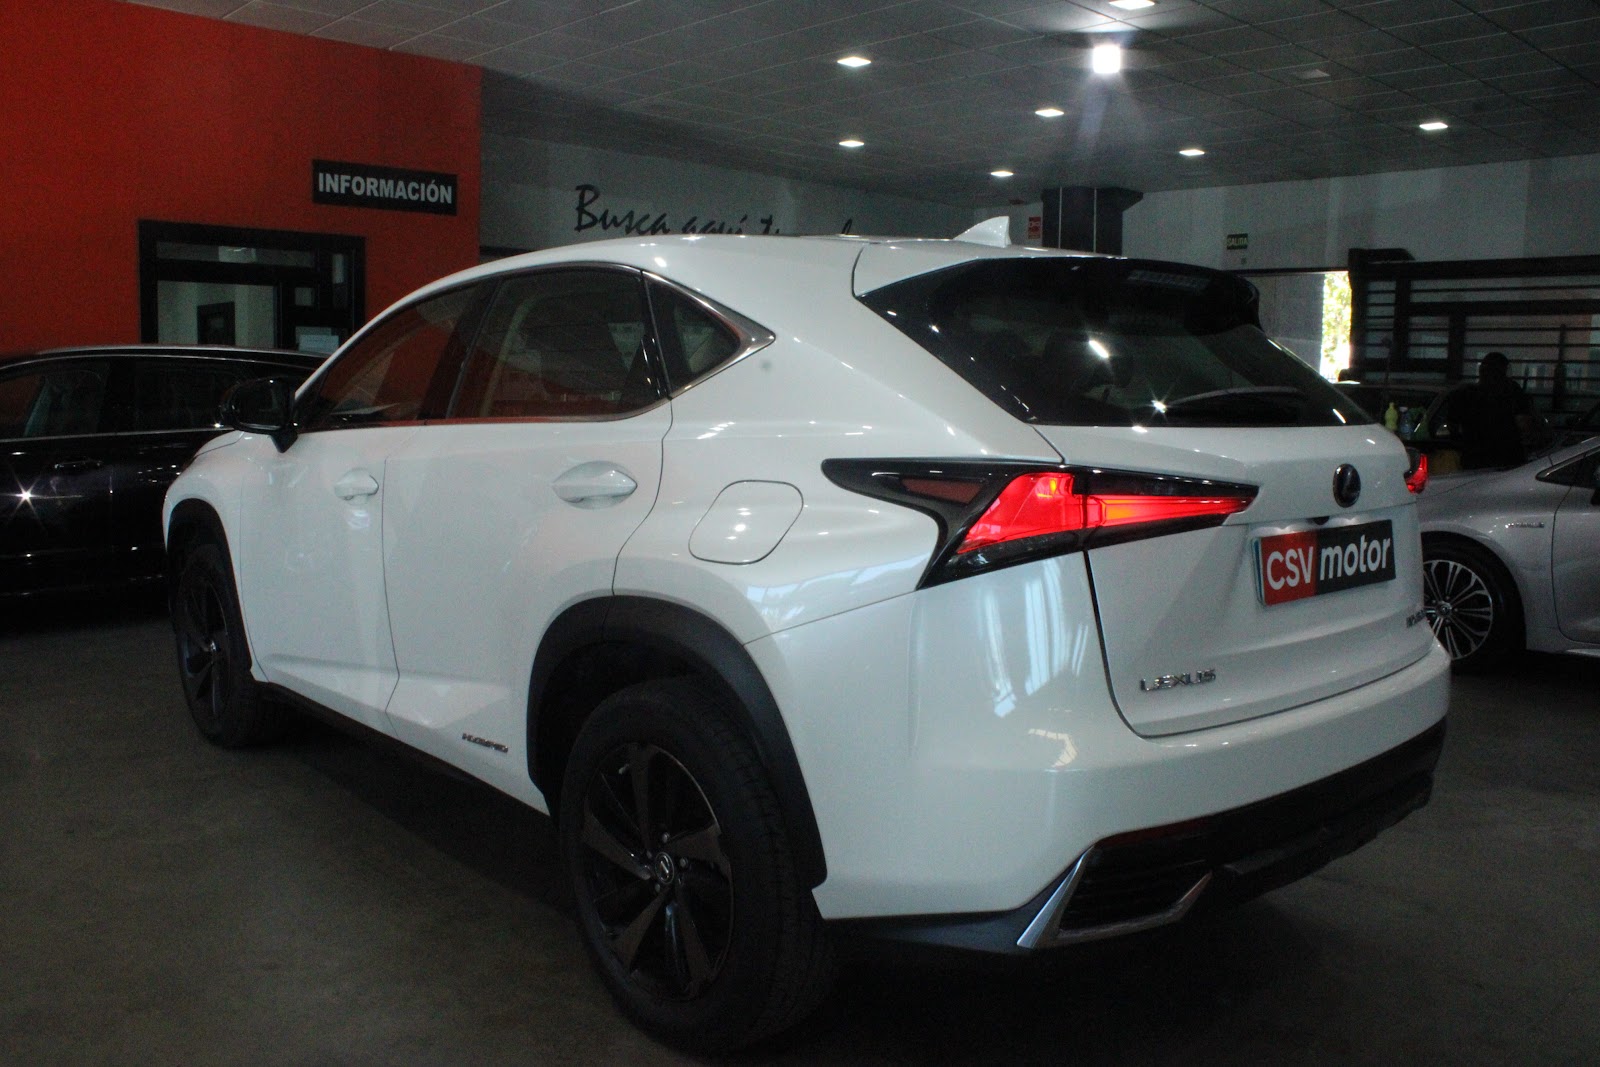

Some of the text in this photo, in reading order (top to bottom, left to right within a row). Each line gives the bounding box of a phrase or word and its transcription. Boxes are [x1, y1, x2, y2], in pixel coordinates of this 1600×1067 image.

[318, 172, 453, 204] INFORMACIÓN
[574, 184, 671, 235] Busca
[1266, 534, 1391, 590] CSV motor
[1140, 668, 1217, 691] LEXUS
